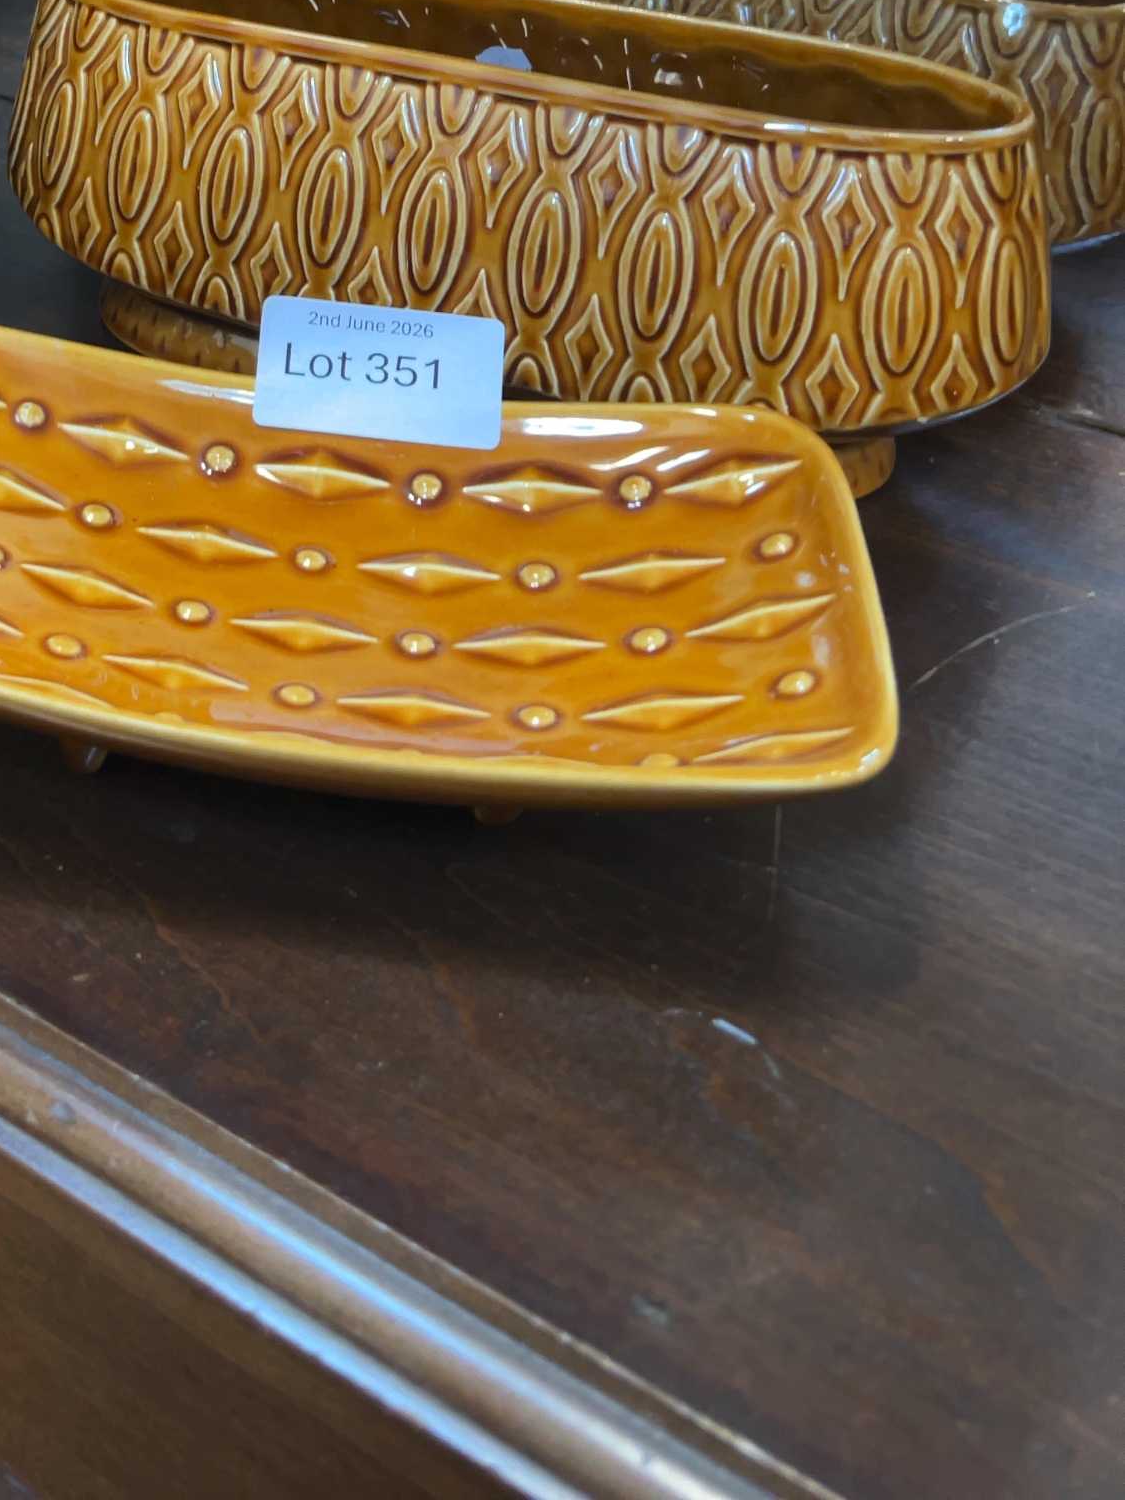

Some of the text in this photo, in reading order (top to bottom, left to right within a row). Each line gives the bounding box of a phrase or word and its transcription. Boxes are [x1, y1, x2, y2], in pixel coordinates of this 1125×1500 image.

[308, 311, 434, 339] 2nd June 2026
[283, 342, 441, 390] Lot 351
